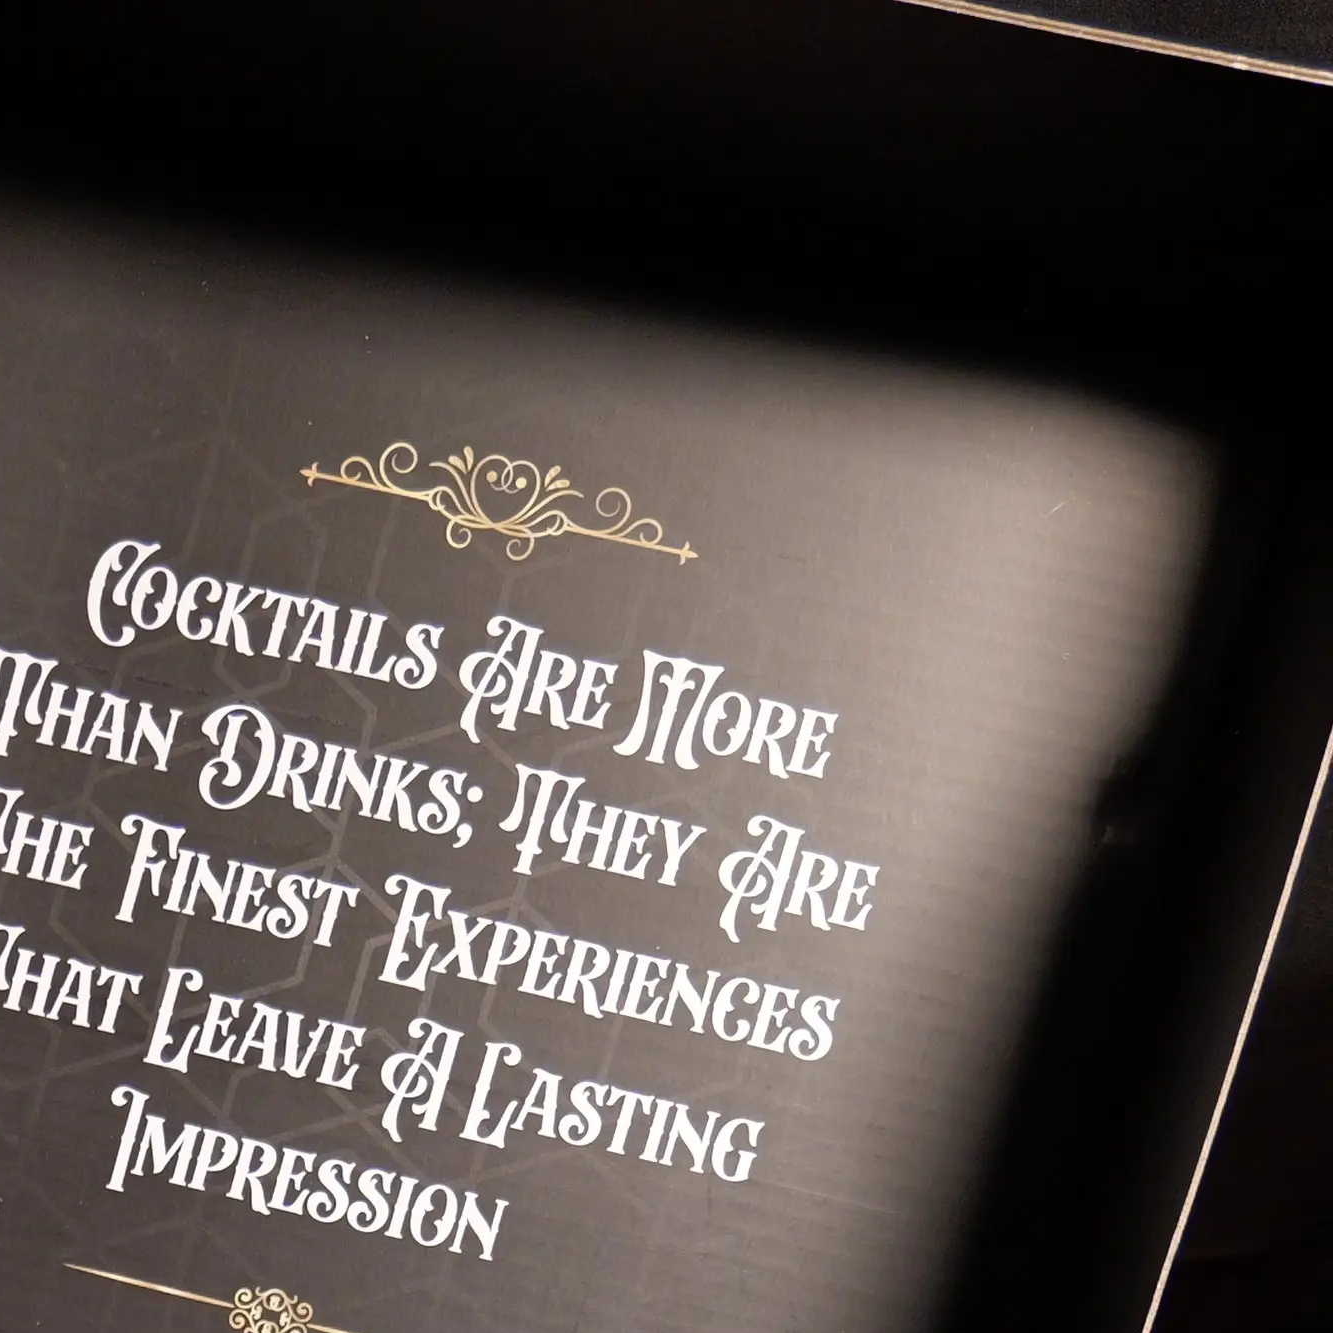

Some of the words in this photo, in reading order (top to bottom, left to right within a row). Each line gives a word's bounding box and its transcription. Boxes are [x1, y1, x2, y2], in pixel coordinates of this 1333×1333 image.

[87, 538, 445, 690] COCKTAILS
[459, 614, 618, 744] ARE
[613, 649, 838, 779] MORE
[114, 813, 360, 948] FINEST
[378, 873, 840, 1062] EXPERIENCES
[499, 763, 708, 887] THEY
[718, 814, 880, 944] ARE
[105, 1085, 510, 1262] IMPRESSION
[143, 967, 367, 1091] LEAVE
[380, 1017, 465, 1143] A
[459, 1041, 765, 1183] LASTING
